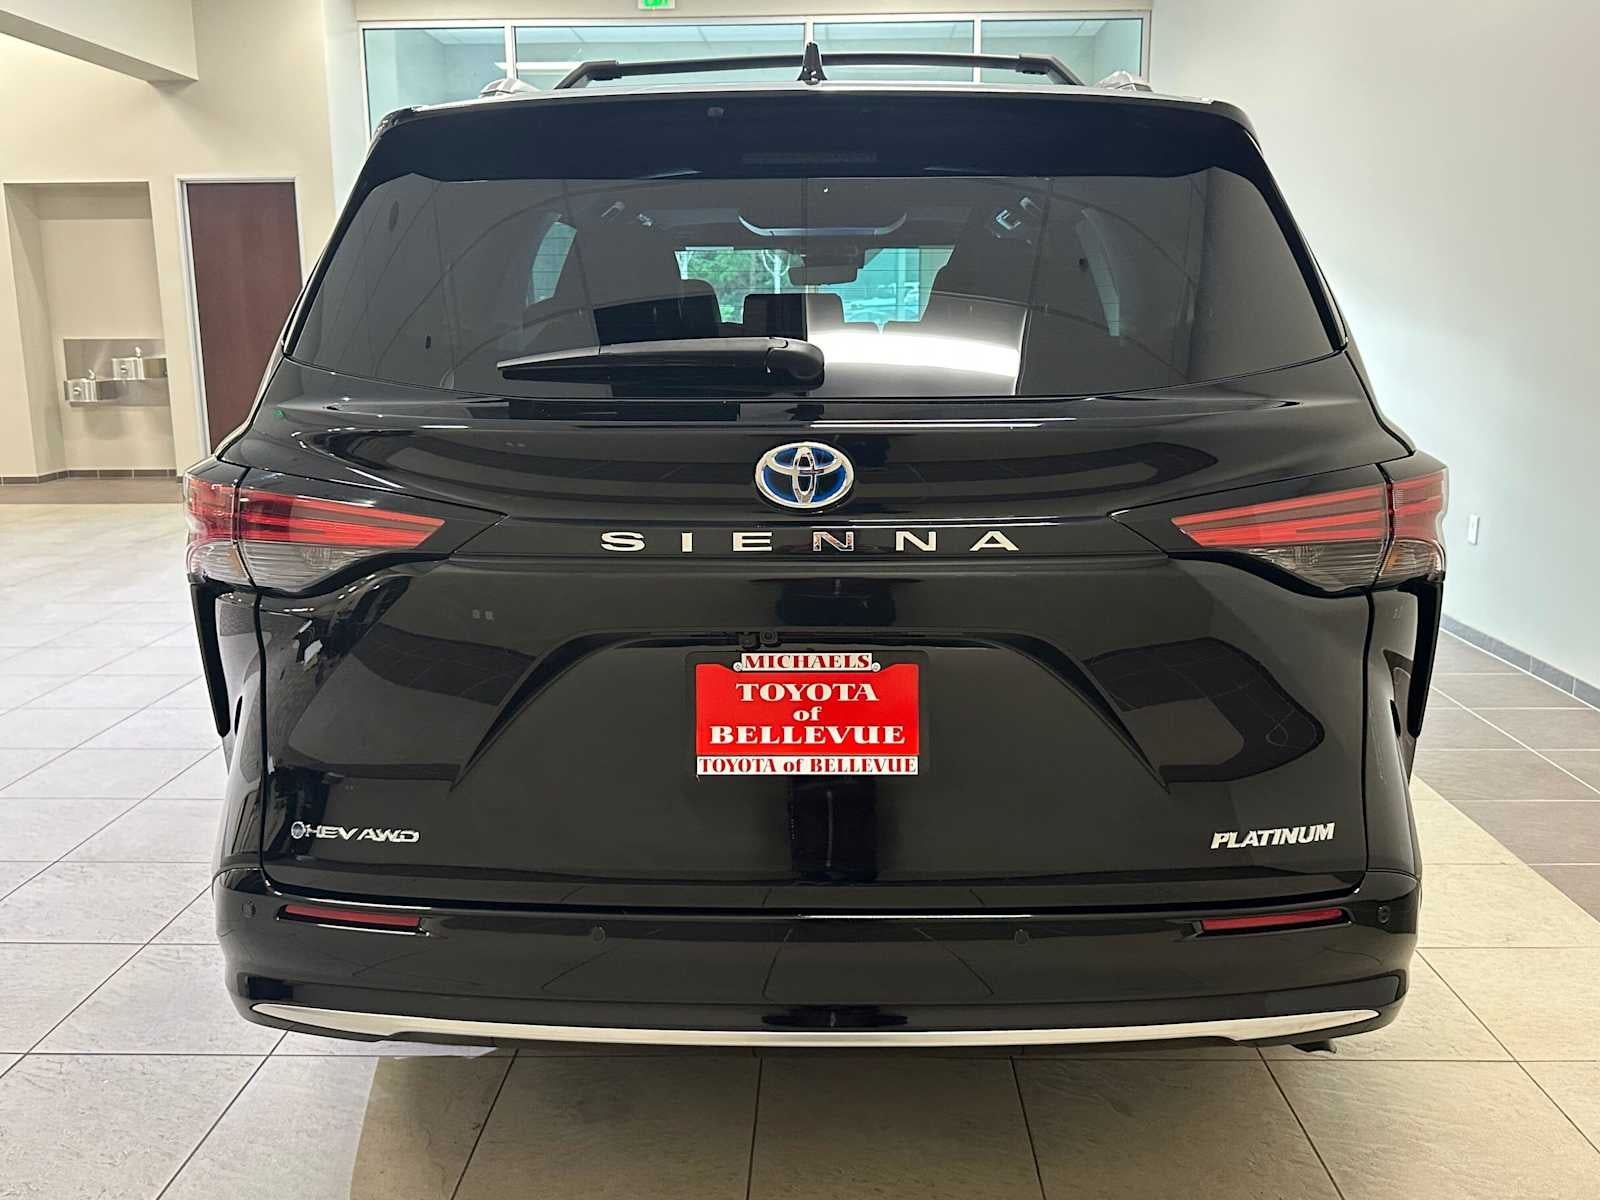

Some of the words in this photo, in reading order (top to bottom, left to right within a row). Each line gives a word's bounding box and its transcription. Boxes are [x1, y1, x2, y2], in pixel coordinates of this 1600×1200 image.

[601, 530, 1020, 553] SIENNA
[744, 655, 870, 669] MICHAELS
[736, 683, 880, 702] TOYOTA
[793, 706, 822, 722] of
[709, 725, 906, 745] BELLEVUE
[699, 758, 776, 773] TOYOTA
[783, 758, 804, 773] of
[810, 758, 916, 773] BELLEVUE
[1210, 822, 1336, 849] PLATINUM
